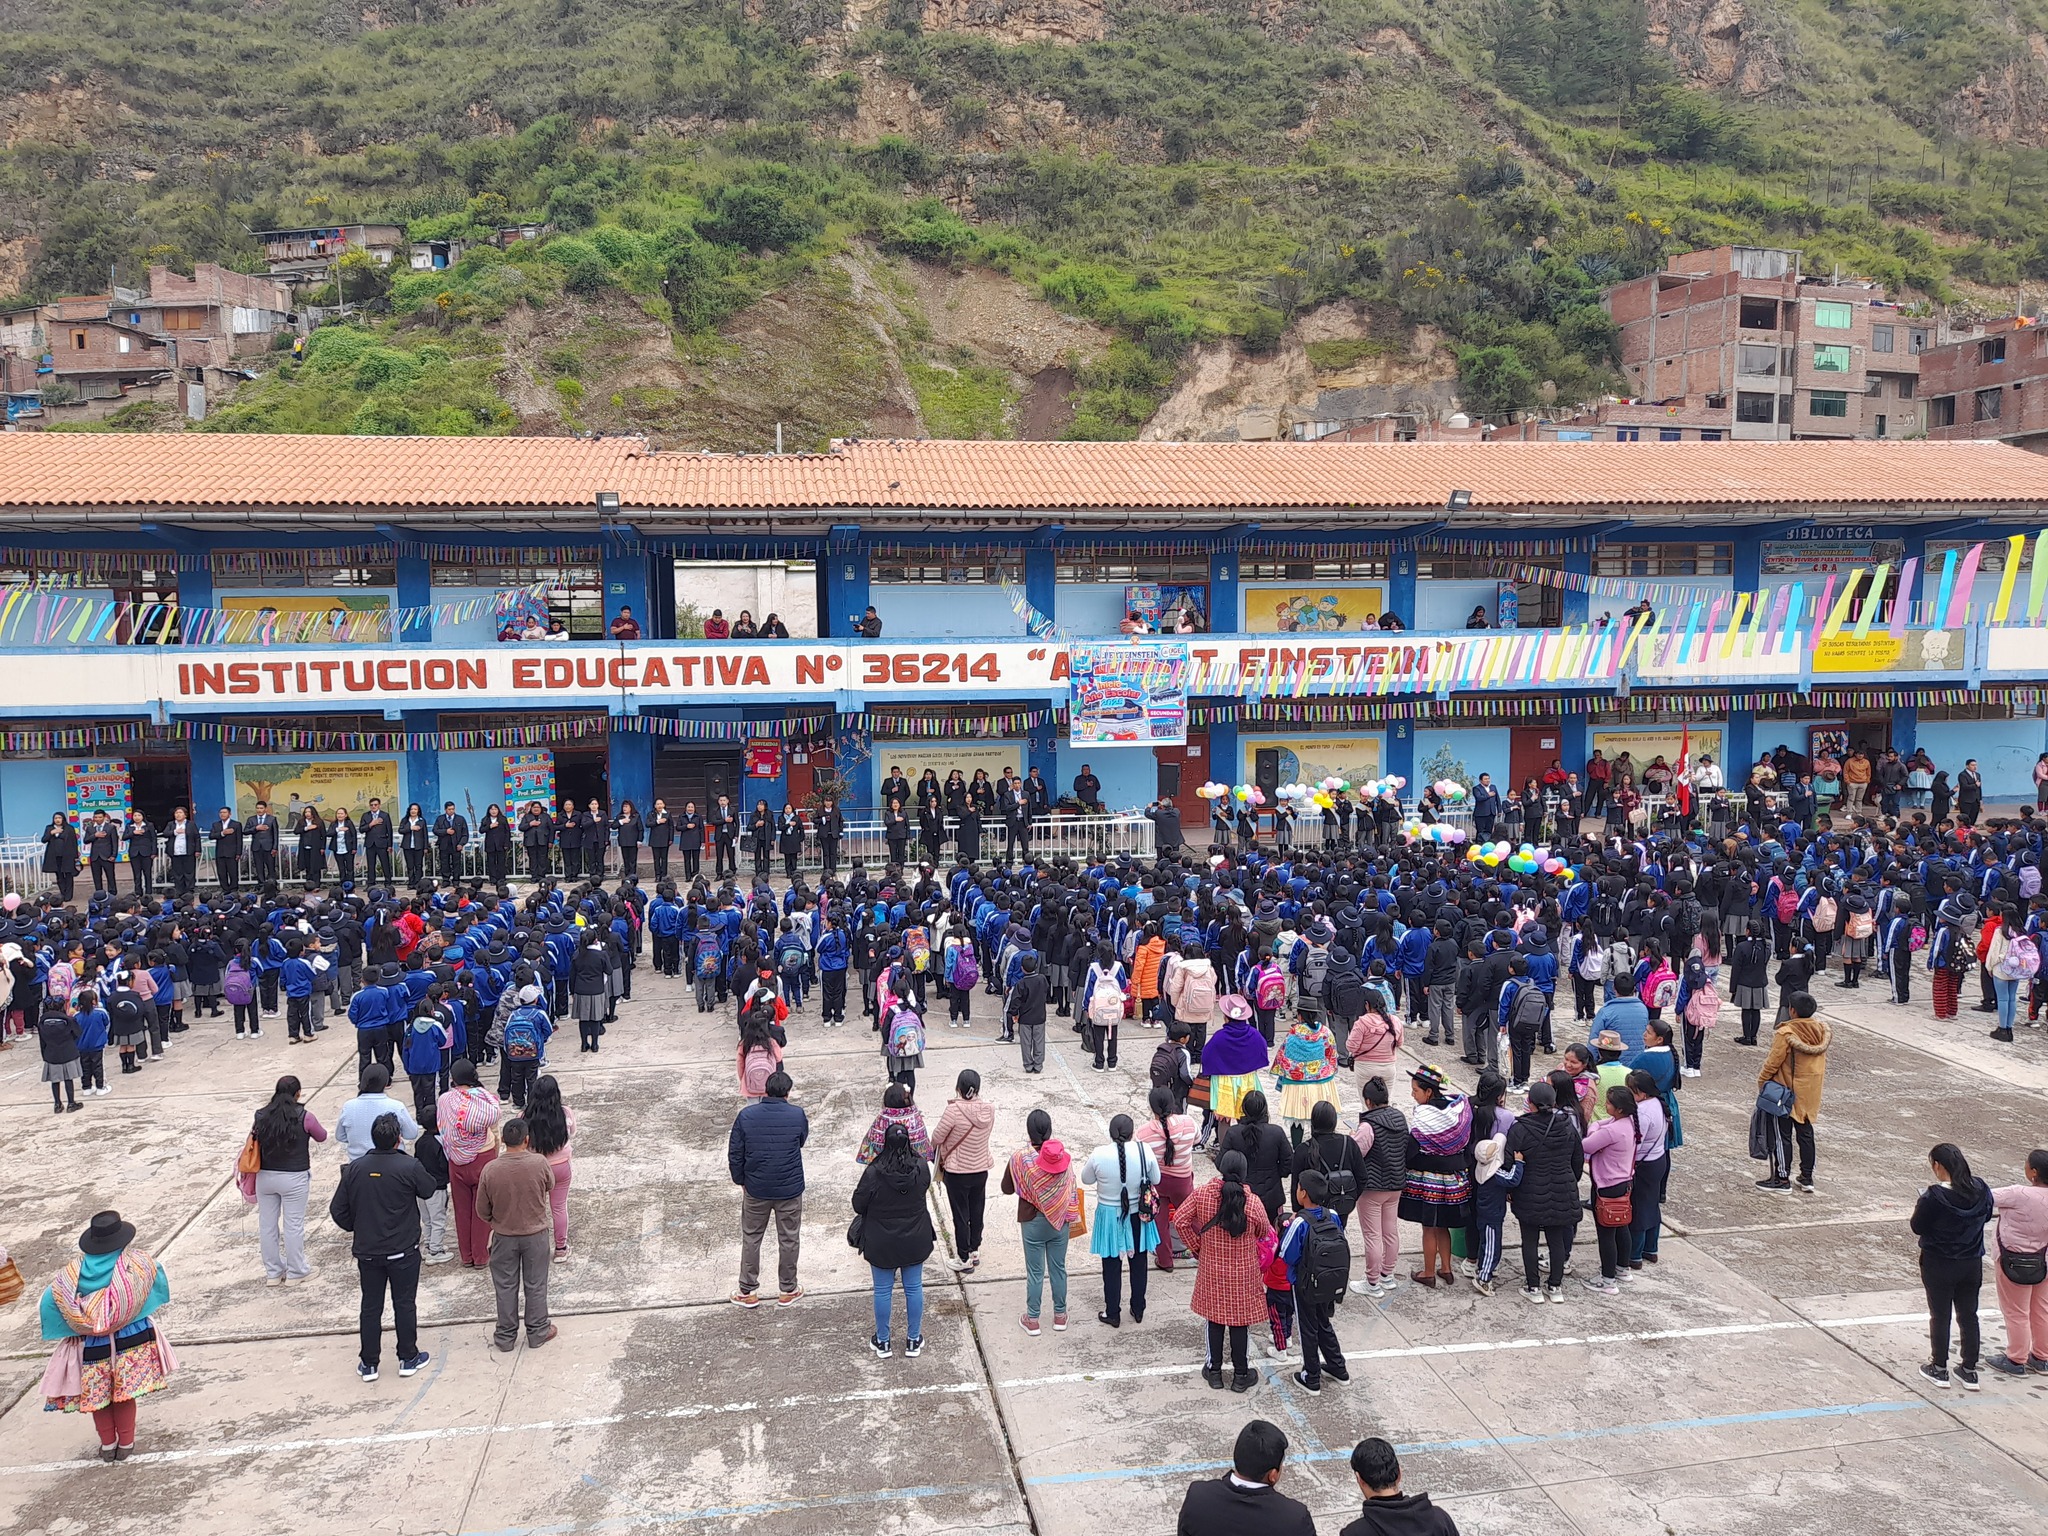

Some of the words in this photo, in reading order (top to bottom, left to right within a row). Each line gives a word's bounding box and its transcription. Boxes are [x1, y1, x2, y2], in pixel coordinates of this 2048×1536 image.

[1786, 527, 1873, 540] BIBLIOTECA
[1220, 566, 1228, 575] S
[178, 658, 488, 695] INSTITUCION
[512, 655, 771, 689] EDUCATIVA
[863, 653, 1000, 684] 36214
[1082, 722, 1096, 735] 17
[510, 764, 549, 775] BIENVENIDOS
[75, 773, 125, 784] BIENVENIDOS
